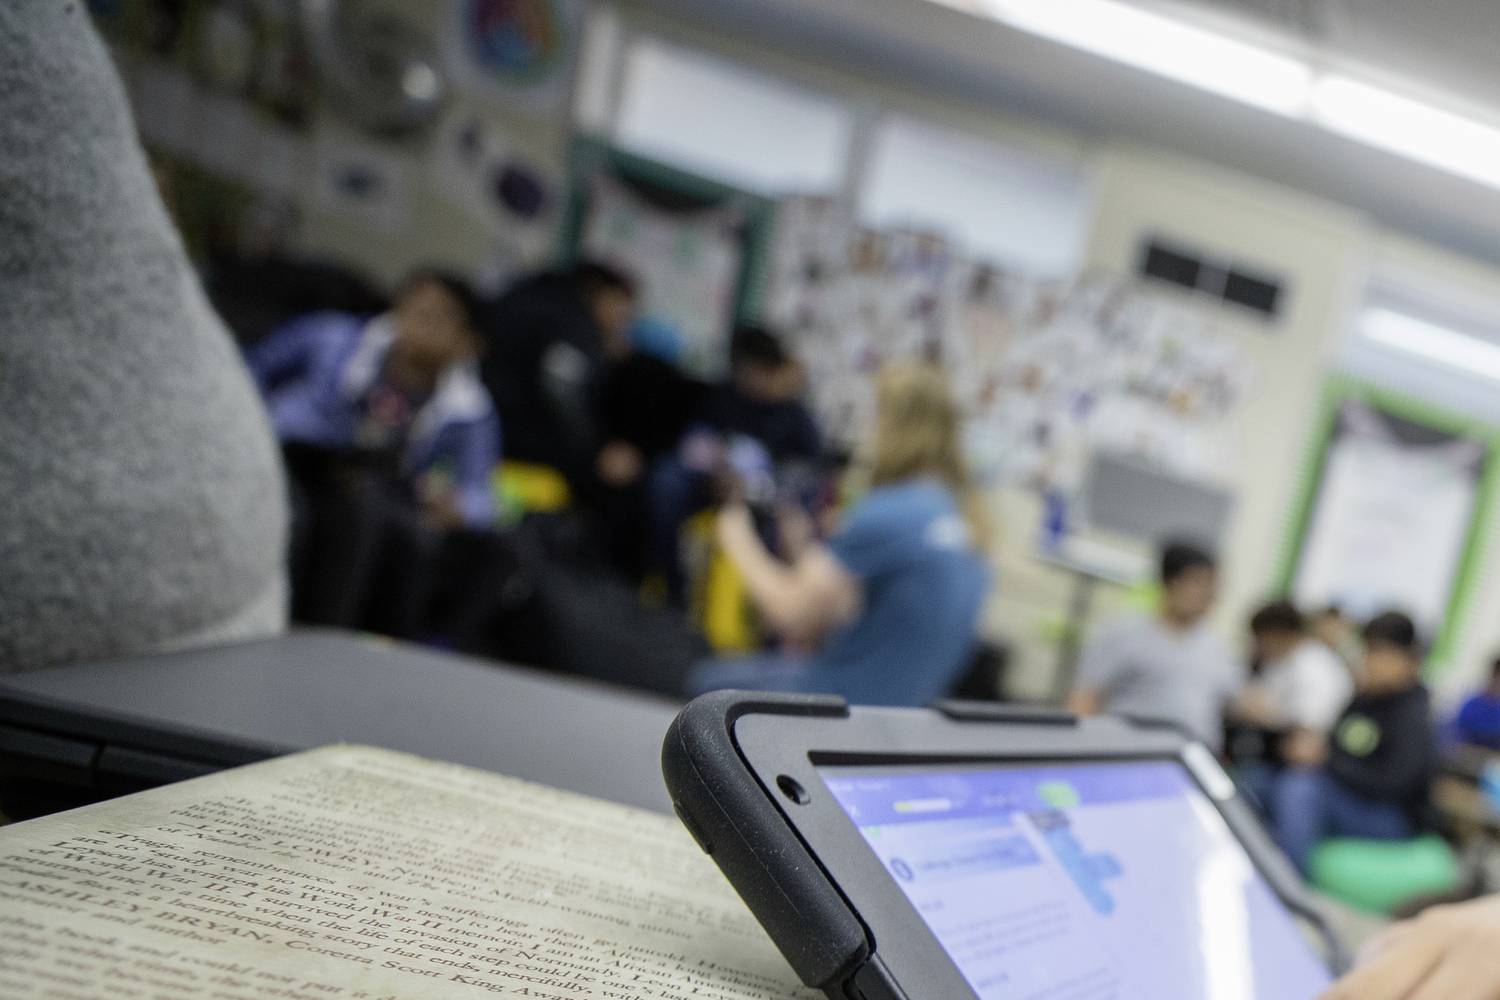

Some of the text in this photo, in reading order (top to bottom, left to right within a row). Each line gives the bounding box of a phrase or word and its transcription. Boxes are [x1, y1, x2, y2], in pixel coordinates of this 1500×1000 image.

[157, 826, 181, 834] of
[363, 870, 401, 882] and
[193, 850, 337, 885] remembrances
[347, 884, 375, 892] of
[379, 891, 432, 906] war’s
[441, 906, 528, 928] sufferings
[539, 927, 584, 940] often
[272, 840, 380, 869] LOWRY,
[4, 855, 111, 877] returned
[109, 874, 146, 886] me
[150, 883, 176, 892] to
[197, 894, 248, 908] time
[255, 907, 312, 923] when
[317, 920, 352, 932] the
[356, 927, 389, 940] life
[393, 937, 423, 946] of
[419, 944, 464, 957] each
[469, 954, 510, 966] step
[514, 964, 571, 977] could
[574, 972, 596, 983] be
[602, 981, 653, 994] one’s
[28, 848, 64, 856] of
[63, 853, 141, 872] World
[146, 869, 197, 884] War
[202, 881, 231, 894] II.
[242, 890, 257, 899] I
[262, 898, 355, 920] survived
[358, 918, 391, 929] the
[399, 926, 478, 948] invasion
[486, 946, 513, 955] of
[512, 951, 621, 978] Normandy.
[632, 974, 681, 990] Leon
[49, 841, 136, 861] Leyson
[140, 857, 176, 870] has
[183, 868, 259, 888] written
[262, 884, 293, 896] his
[300, 892, 368, 912] World
[372, 908, 416, 923] War
[420, 919, 442, 930] II
[448, 928, 523, 947] memoir.
[531, 943, 540, 951] I
[546, 948, 574, 959] am
[579, 955, 600, 964] an
[606, 960, 672, 978] African
[686, 976, 762, 999] American
[72, 836, 108, 845] are
[114, 843, 139, 852] to
[223, 865, 263, 878] war
[267, 876, 295, 886] no
[381, 900, 408, 911] we
[415, 910, 465, 923] need
[469, 920, 489, 929] to
[496, 926, 537, 939] hear
[544, 937, 590, 951] them.
[603, 949, 647, 963] After
[675, 964, 712, 980] long
[91, 913, 227, 944] and author
[123, 888, 143, 898] is
[167, 898, 320, 938] heartbreaking
[322, 935, 380, 950] story
[383, 947, 423, 959] that
[429, 958, 480, 972] ends,
[488, 969, 592, 994] mercifully,
[155, 911, 273, 944] BRYAN,
[285, 940, 374, 964] Coretta
[380, 961, 443, 978] Scott
[448, 974, 505, 992] King
[300, 982, 344, 994] put
[351, 991, 369, 1000] it
